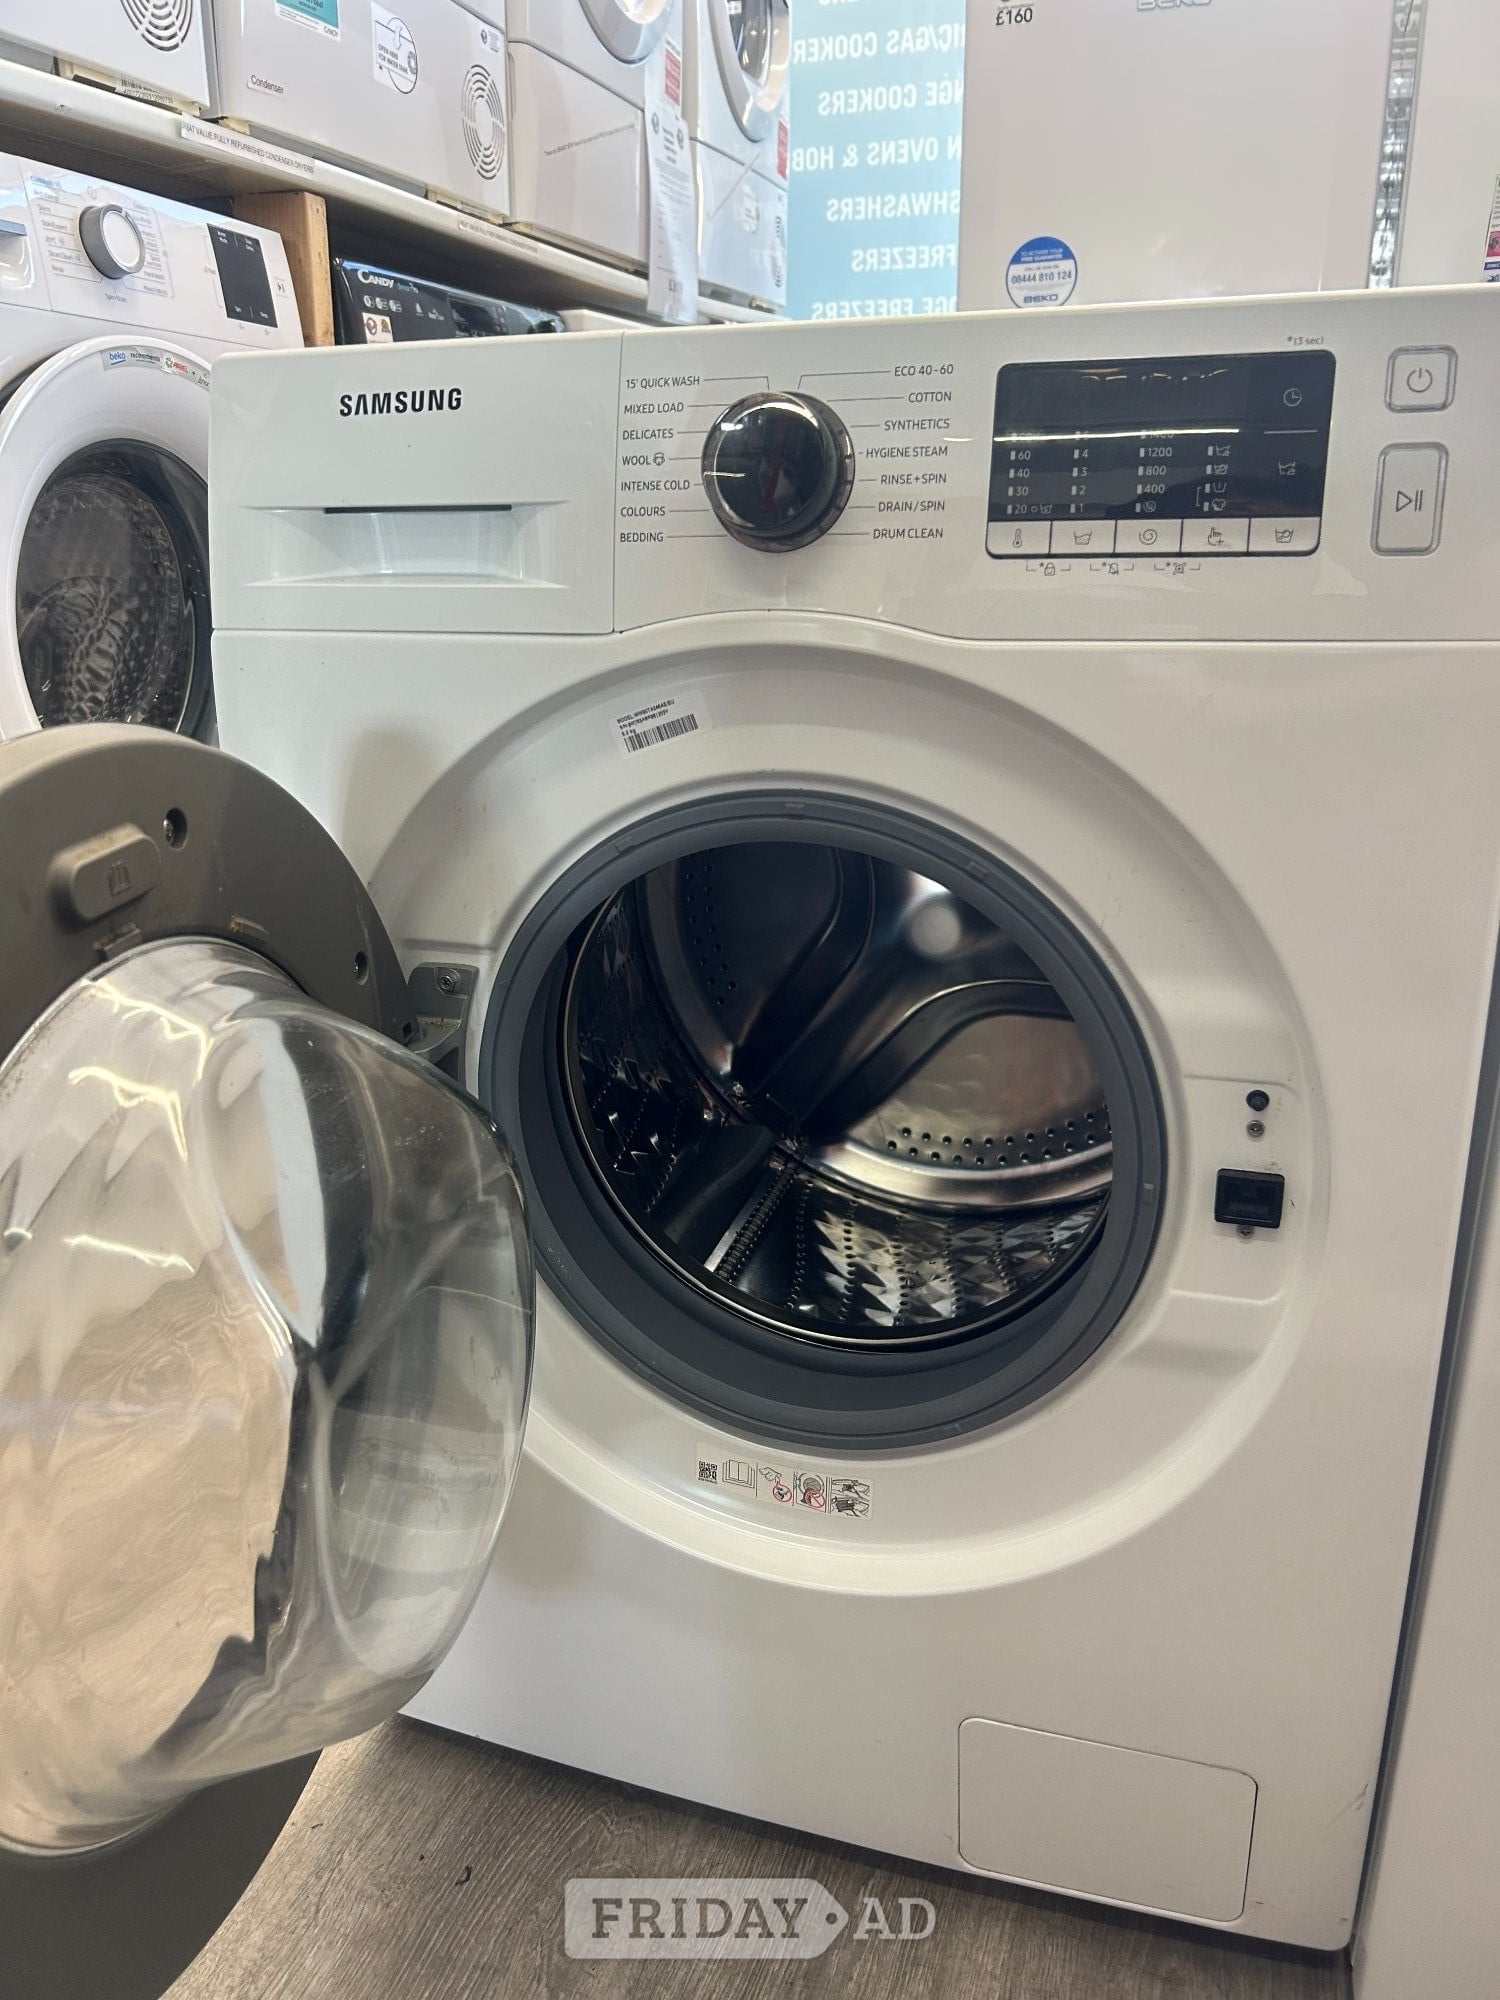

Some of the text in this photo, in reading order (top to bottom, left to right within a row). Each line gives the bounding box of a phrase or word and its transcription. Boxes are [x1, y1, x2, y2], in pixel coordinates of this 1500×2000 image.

[996, 8, 1033, 25] £160
[250, 74, 284, 94] Condenser
[196, 126, 213, 140] VALUE
[214, 133, 230, 146] FULLY
[230, 139, 264, 157] REFURBISHED
[265, 150, 295, 167] CONDENSER
[295, 160, 314, 174] DRYERS
[1038, 272, 1054, 282] 810
[1057, 270, 1072, 280] 124
[1024, 294, 1058, 304] BEKO
[109, 352, 126, 360] beko
[894, 366, 916, 376] ECO
[640, 377, 670, 390] QUICK
[672, 376, 700, 387] WASH
[340, 388, 462, 417] SAMSUNG
[908, 391, 952, 403] COTTON
[624, 402, 684, 414] MIXED LOAD
[884, 418, 950, 431] SYNTHETICS
[622, 428, 674, 440] DELICATES
[866, 446, 948, 458] HYGIENE STEAM
[1018, 450, 1032, 460] 60
[1081, 449, 1089, 459] 4
[1148, 446, 1172, 458] 1200
[622, 455, 651, 466] WOOL
[1016, 468, 1030, 478] 40
[1080, 466, 1088, 477] 3
[1145, 466, 1167, 476] 800
[880, 473, 947, 485] RINSE+SPIN
[621, 480, 690, 492] INTENSE COLD
[1016, 486, 1029, 496] 30
[1079, 485, 1086, 496] 2
[1144, 484, 1166, 494] 400
[620, 506, 666, 518] COLOURS
[878, 500, 946, 512] DRAIN/SPIN
[1014, 504, 1028, 514] 20
[620, 532, 664, 542] BEDDING
[873, 528, 944, 540] DRUM CLEAN
